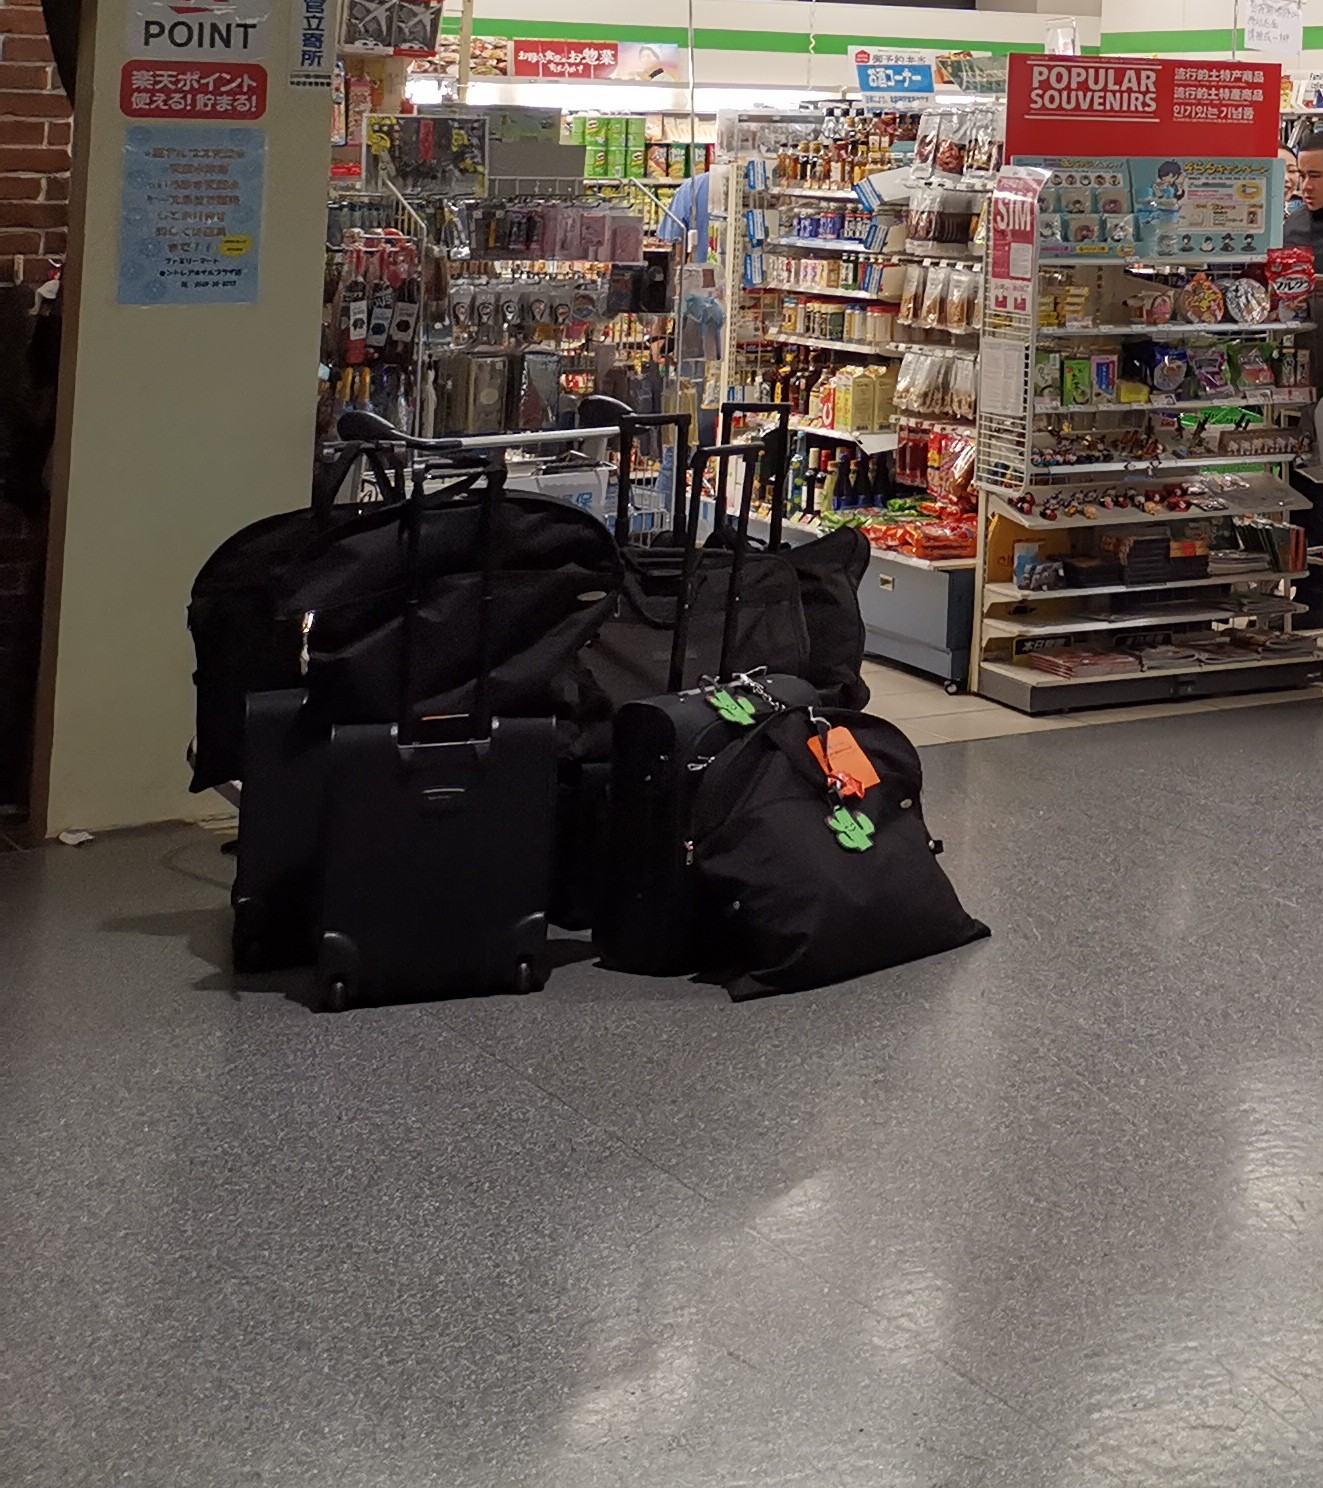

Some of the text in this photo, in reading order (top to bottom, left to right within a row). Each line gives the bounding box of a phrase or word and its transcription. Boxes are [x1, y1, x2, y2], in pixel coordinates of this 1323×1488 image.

[143, 20, 257, 49] POINT
[131, 70, 257, 92] 楽天ポイント
[1032, 66, 1157, 92] POPULAR
[1029, 89, 1157, 113] SOUVENIRS
[995, 196, 1032, 230] SIM
